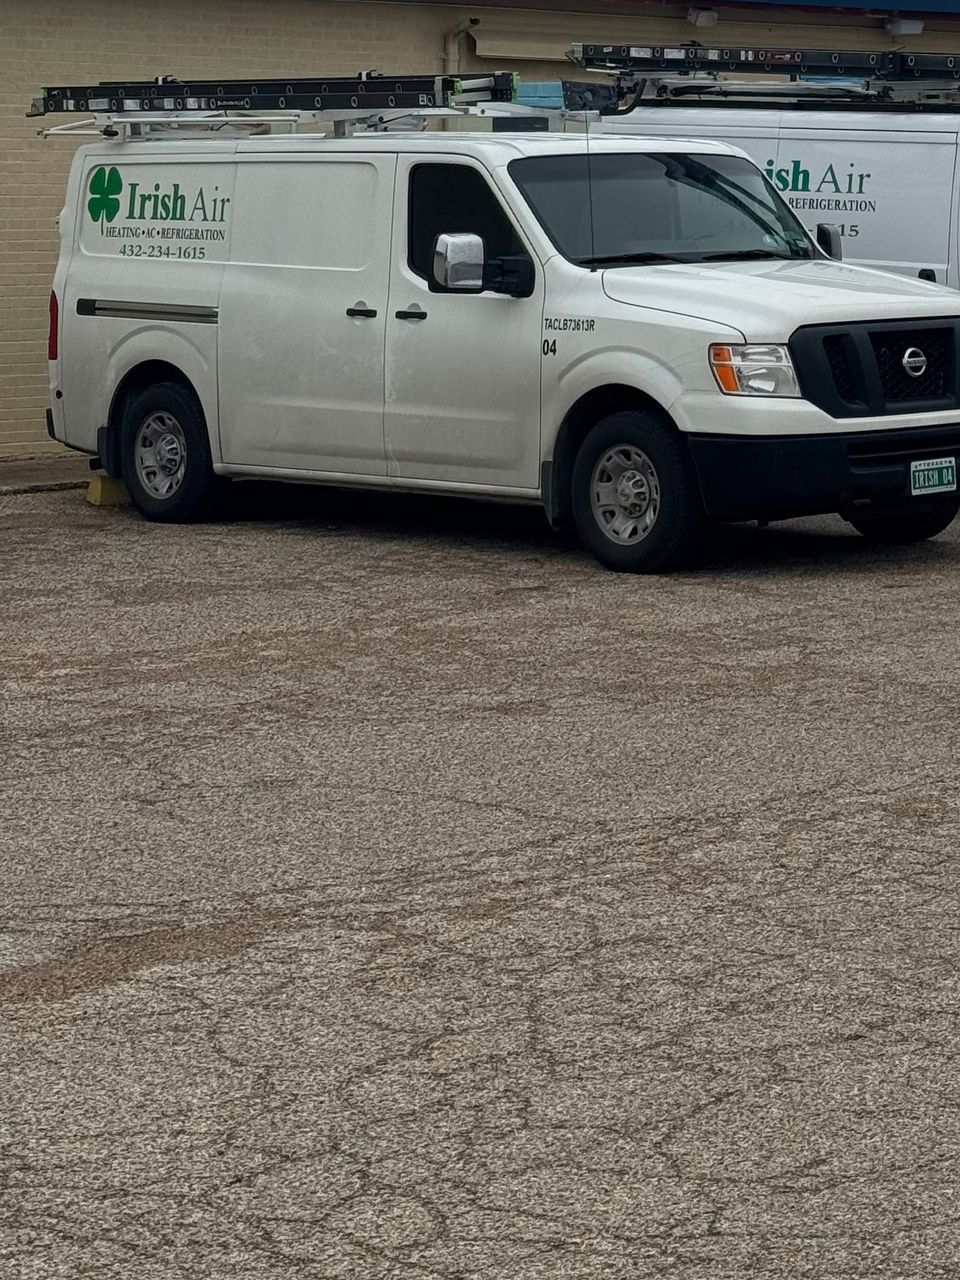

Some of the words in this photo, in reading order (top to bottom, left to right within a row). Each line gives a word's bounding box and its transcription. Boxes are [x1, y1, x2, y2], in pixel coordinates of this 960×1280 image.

[762, 159, 811, 192] ish
[814, 162, 872, 194] Air
[125, 183, 186, 221] Irish
[188, 185, 231, 222] Air
[788, 197, 877, 212] REFRIGERATION
[105, 227, 141, 239] HEATING
[144, 229, 156, 239] AC
[160, 227, 226, 241] REFRIGERATION
[119, 244, 206, 260] 432-234-1615
[544, 318, 595, 331] TACLB73613R
[542, 339, 557, 356] 04
[914, 469, 939, 488] IRISH
